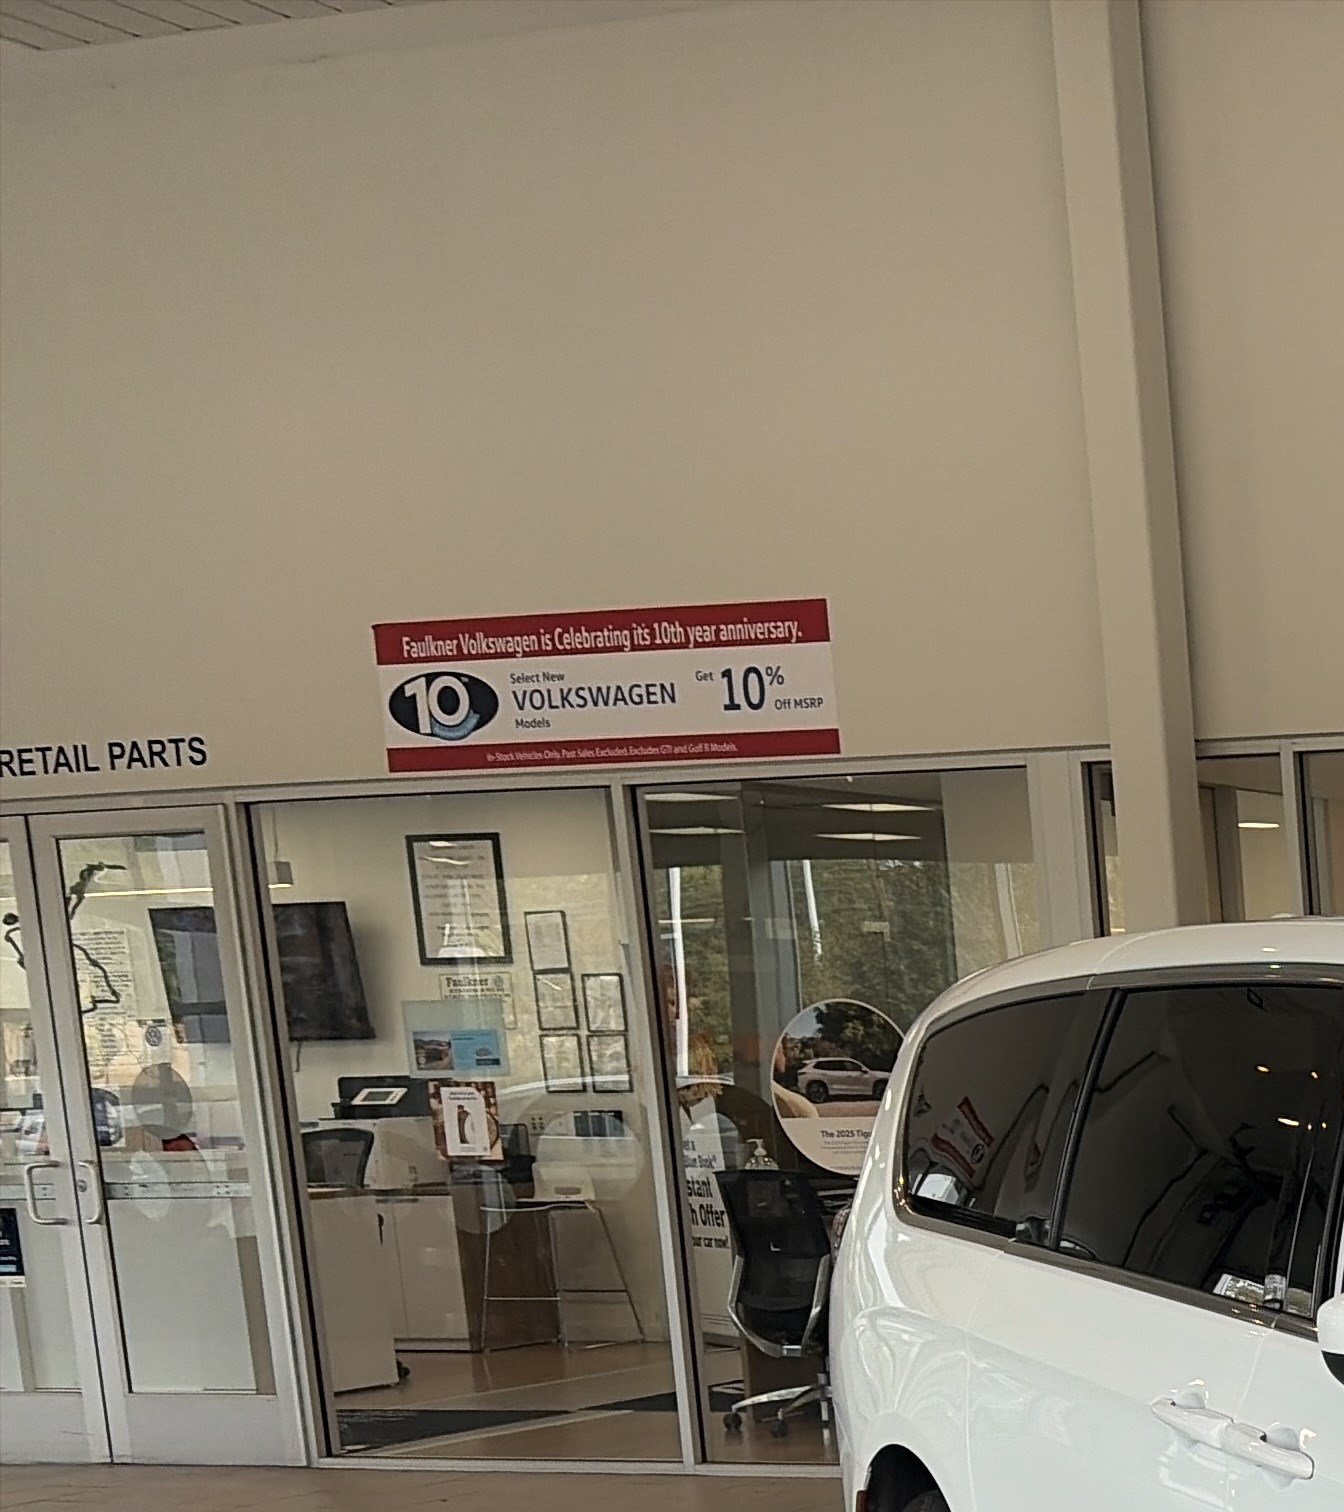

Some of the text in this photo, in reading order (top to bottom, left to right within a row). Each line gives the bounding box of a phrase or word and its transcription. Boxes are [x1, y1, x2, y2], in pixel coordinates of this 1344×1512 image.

[402, 635, 458, 658] Faulkner
[459, 632, 539, 658] Volkswagen
[540, 629, 552, 651] is
[554, 624, 631, 652] Celebrating
[653, 621, 685, 645] 10th
[687, 623, 716, 648] year
[719, 617, 803, 644] anniversary.
[510, 671, 565, 684] Select New
[695, 670, 713, 682] Get
[512, 682, 677, 711] VOLKSWAGEN
[774, 697, 824, 710] Off MSRP
[515, 718, 551, 729] Models
[0, 736, 208, 777] RETAIL PARTS
[821, 1130, 834, 1138] The
[836, 1130, 855, 1138] 2025
[699, 1203, 725, 1228] Offer
